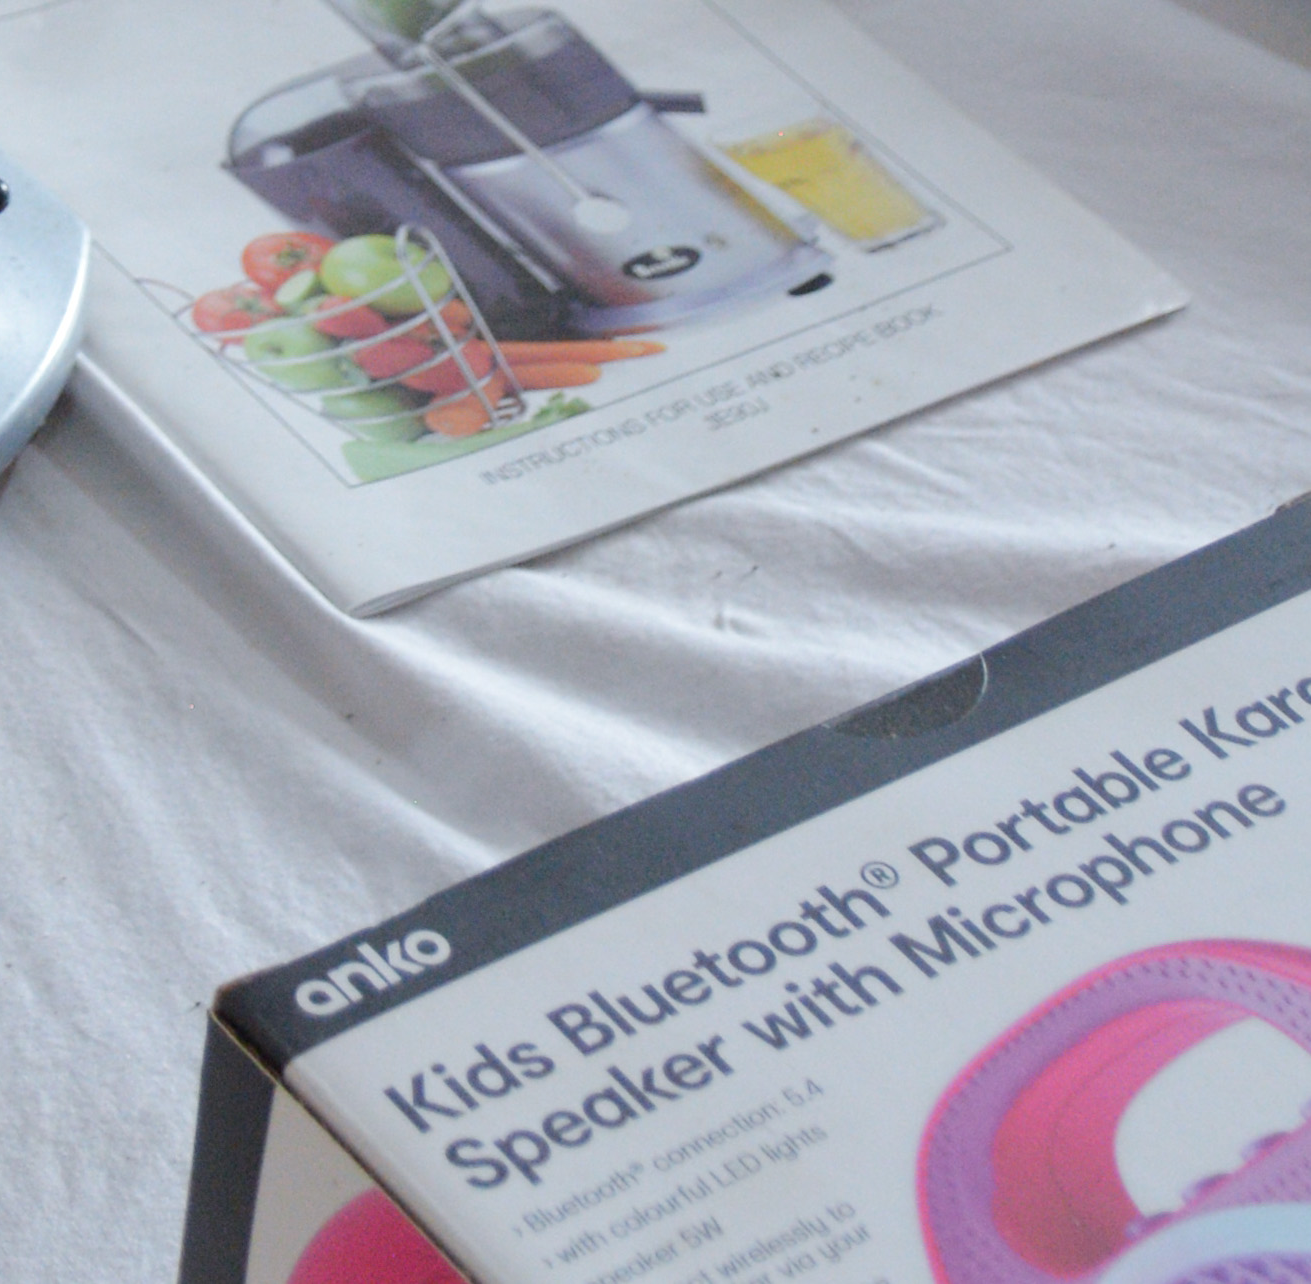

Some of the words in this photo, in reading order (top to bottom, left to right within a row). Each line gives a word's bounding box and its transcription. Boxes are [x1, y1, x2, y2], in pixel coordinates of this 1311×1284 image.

[479, 417, 647, 484] INSTRUCTIONS
[644, 398, 690, 427] FOR
[693, 380, 745, 407] USE
[745, 359, 796, 389] AND
[793, 330, 876, 369] RECIPE
[873, 305, 944, 338] BOOK
[294, 929, 452, 1017] anko
[383, 1041, 556, 1134] Kids
[908, 747, 1192, 888] Portable
[444, 1034, 735, 1190] Speaker
[741, 961, 904, 1052] with
[888, 783, 1287, 979] Microphone
[652, 1104, 787, 1174] connection:
[781, 1077, 825, 1107] 5.4
[555, 1233, 609, 1267] with
[609, 1177, 716, 1239] colourful
[711, 1151, 762, 1188] LED
[759, 1122, 829, 1163] lights
[680, 1215, 726, 1250] 5W
[715, 1215, 831, 1279] wirelessly
[826, 1201, 856, 1223] to
[779, 1252, 818, 1279] via
[816, 1223, 871, 1263] your
